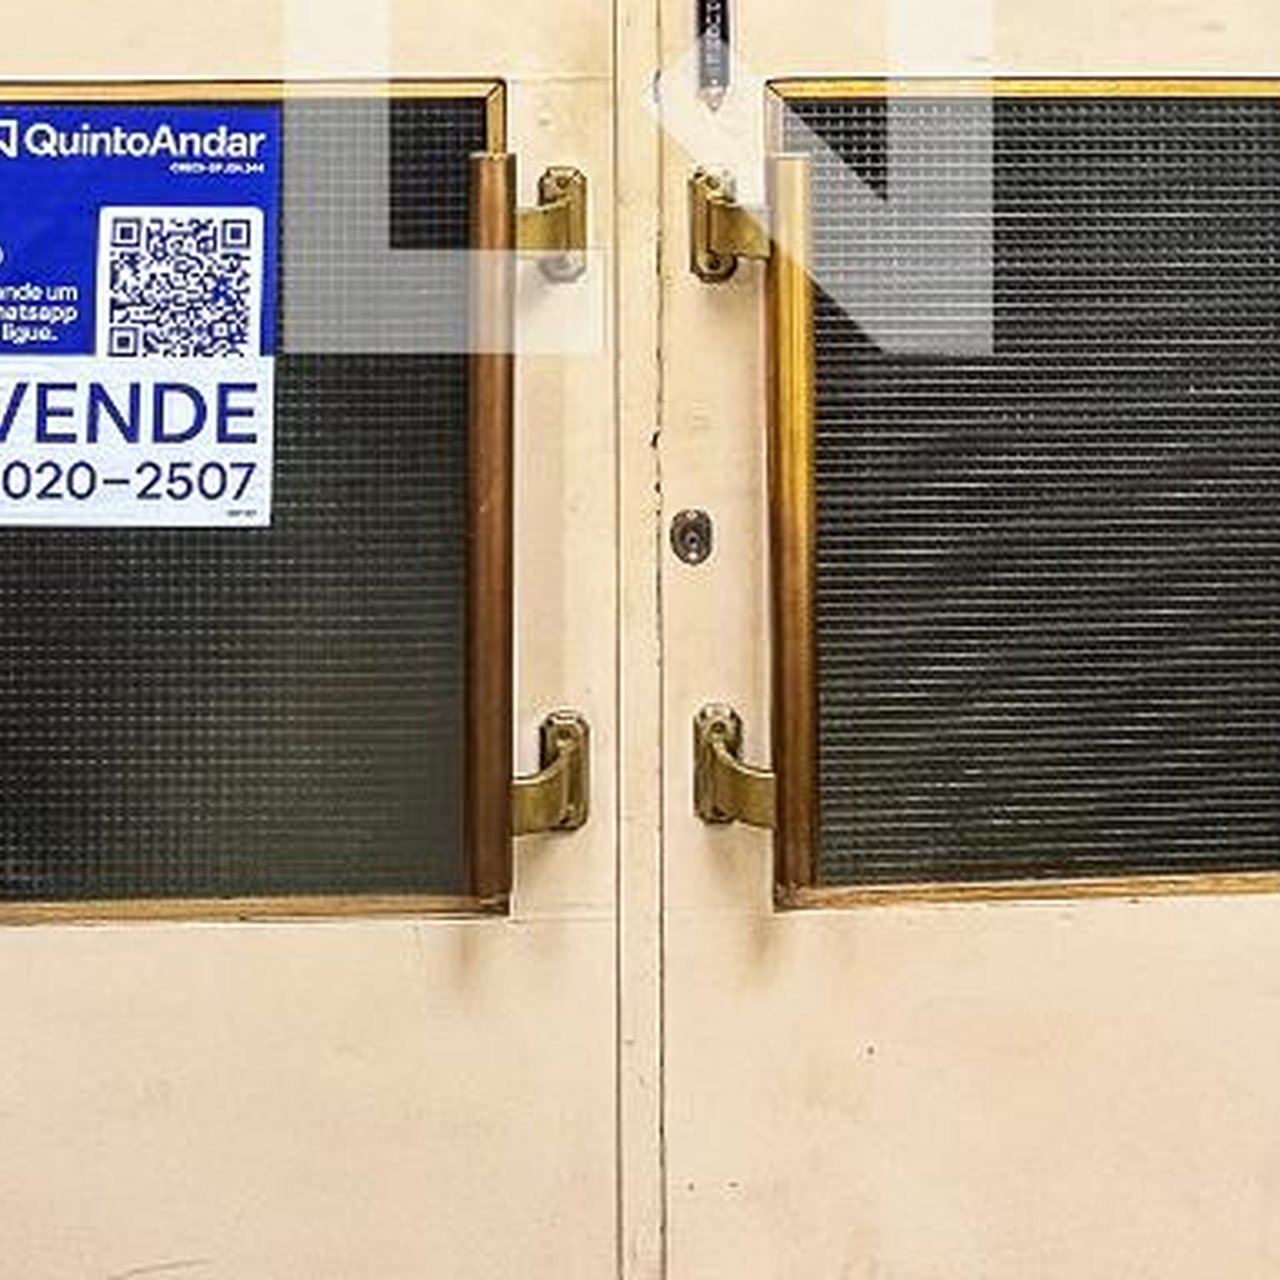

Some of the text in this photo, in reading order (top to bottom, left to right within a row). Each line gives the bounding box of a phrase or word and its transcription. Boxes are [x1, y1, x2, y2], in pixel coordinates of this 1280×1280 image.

[24, 123, 265, 158] QuintoAndar
[46, 286, 78, 300] um
[2, 323, 58, 344] ligue.
